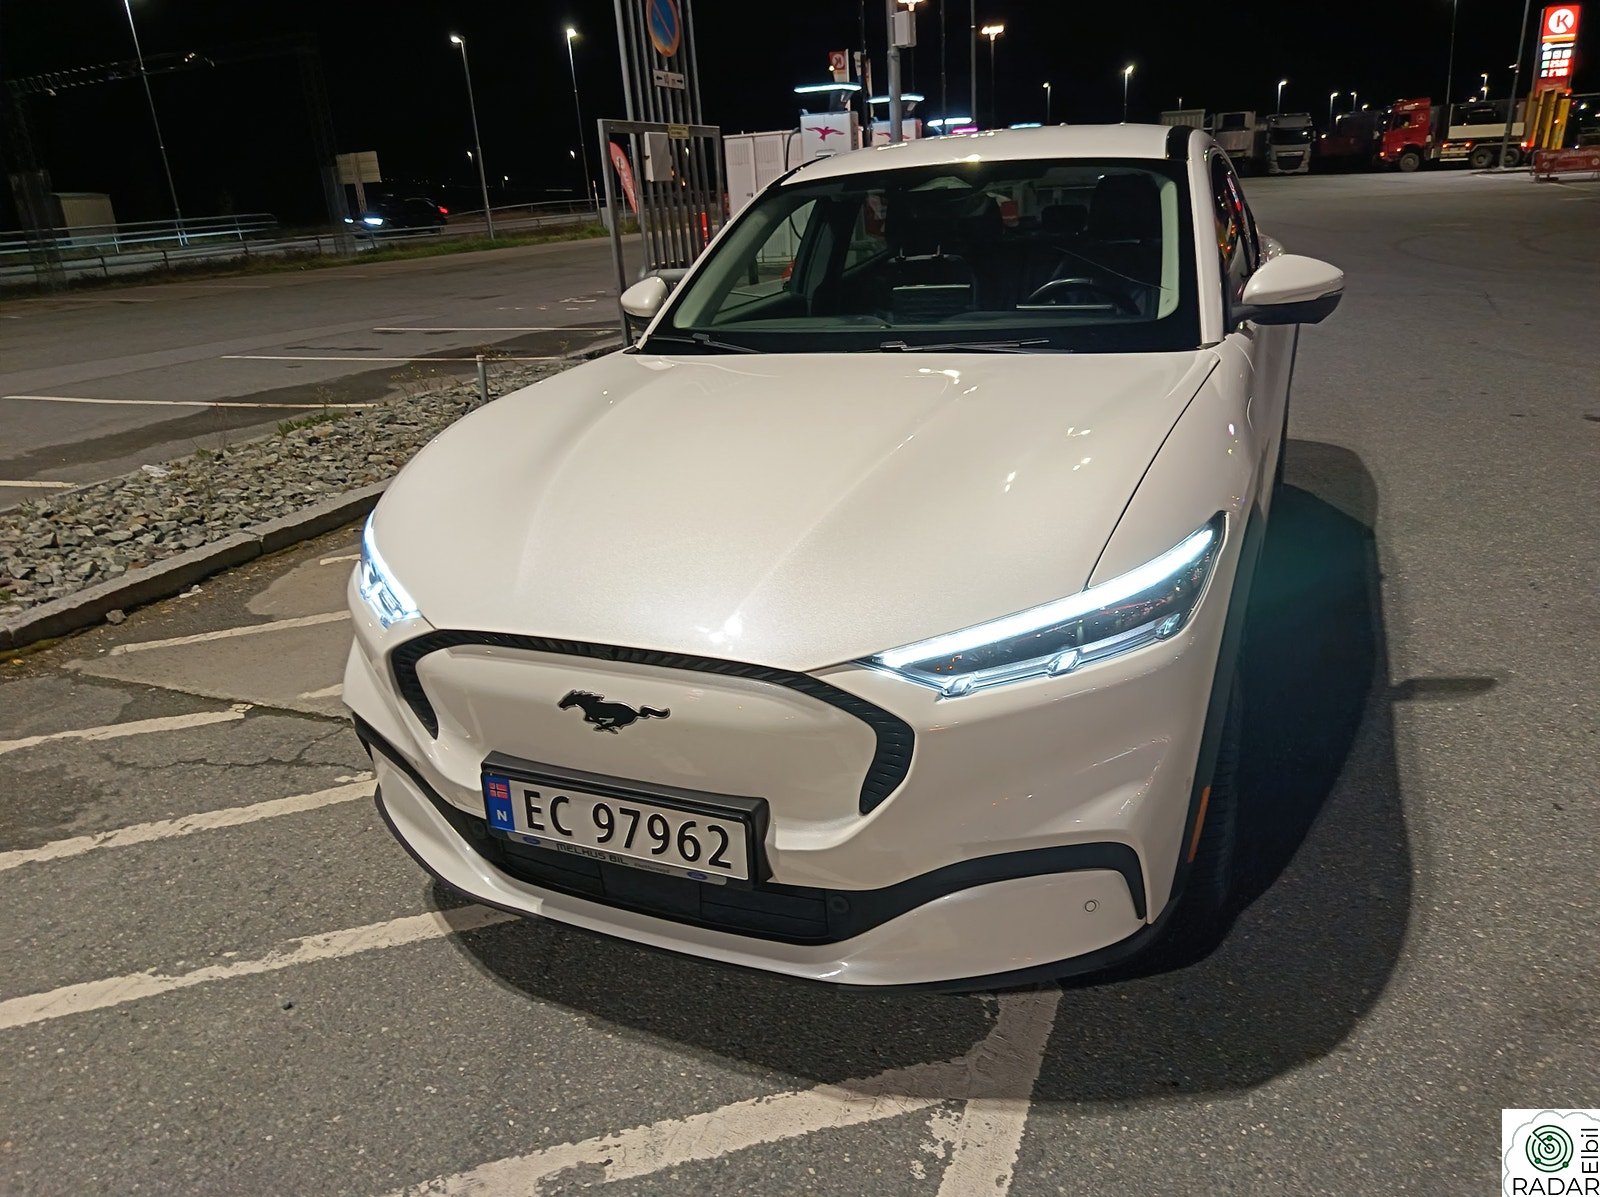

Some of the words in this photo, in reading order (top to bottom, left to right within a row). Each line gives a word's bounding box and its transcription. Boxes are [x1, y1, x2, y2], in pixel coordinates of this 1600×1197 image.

[496, 809, 508, 822] N
[523, 789, 573, 837] EC
[592, 803, 732, 870] 97962
[556, 843, 606, 860] MELHUS
[609, 854, 628, 866] BIL
